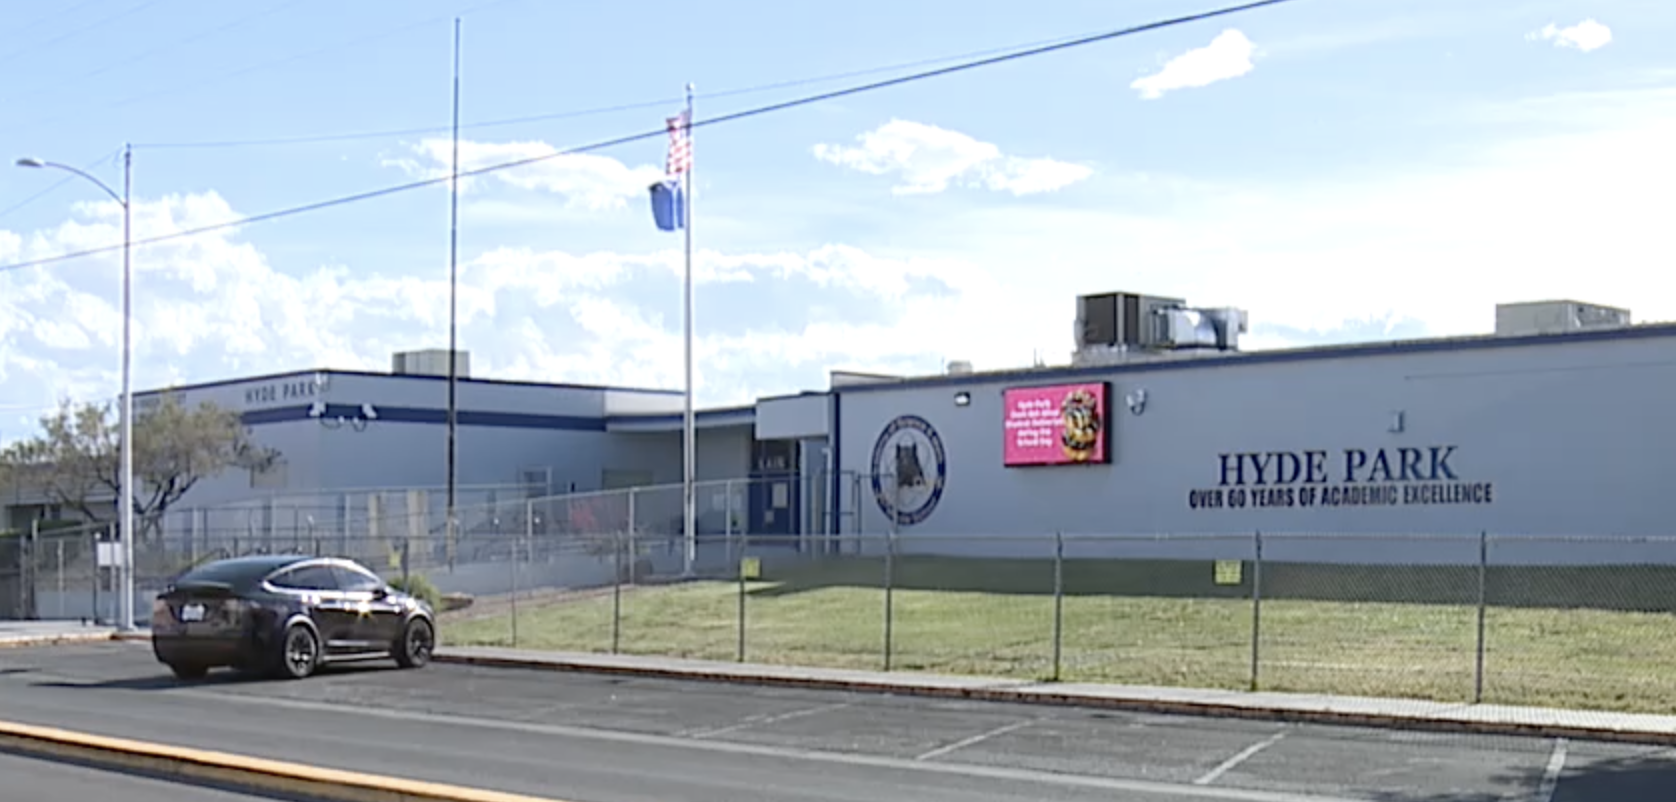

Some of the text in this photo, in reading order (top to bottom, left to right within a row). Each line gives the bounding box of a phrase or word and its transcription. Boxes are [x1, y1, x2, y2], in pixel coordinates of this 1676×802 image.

[245, 384, 276, 405] HYDE
[1218, 445, 1459, 486] HYDE PARK
[1189, 482, 1493, 509] OVER 60 YEARS OF ACADEMIC EXCELLENCE
